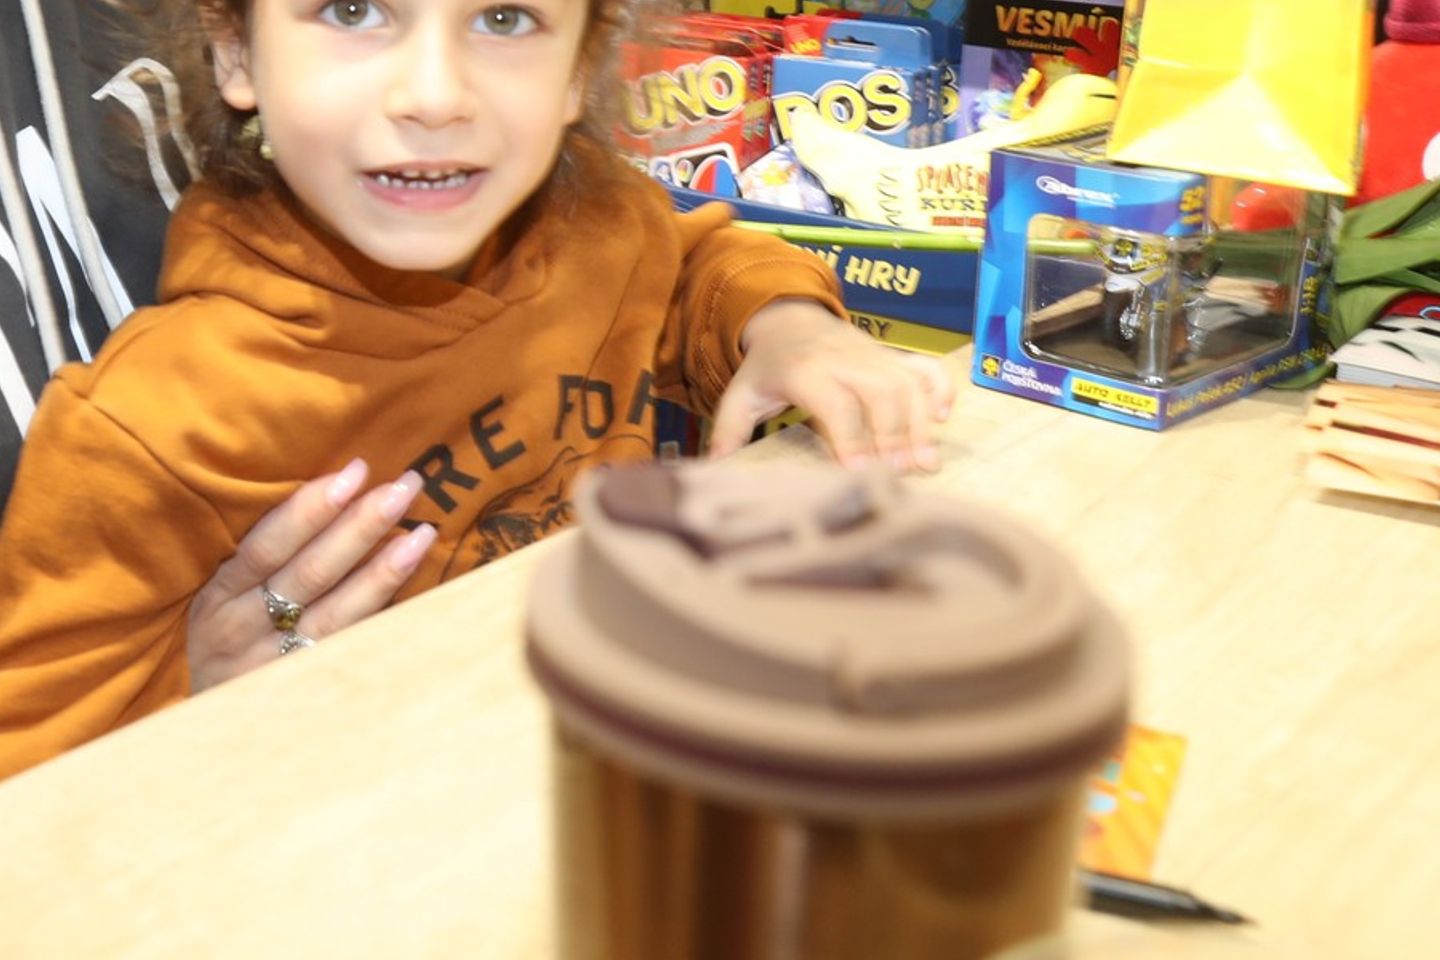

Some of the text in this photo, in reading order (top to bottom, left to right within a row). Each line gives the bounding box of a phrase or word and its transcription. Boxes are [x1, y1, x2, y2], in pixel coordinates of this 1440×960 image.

[624, 56, 747, 138] UNO
[844, 254, 922, 297] HRY
[850, 313, 892, 339] RY
